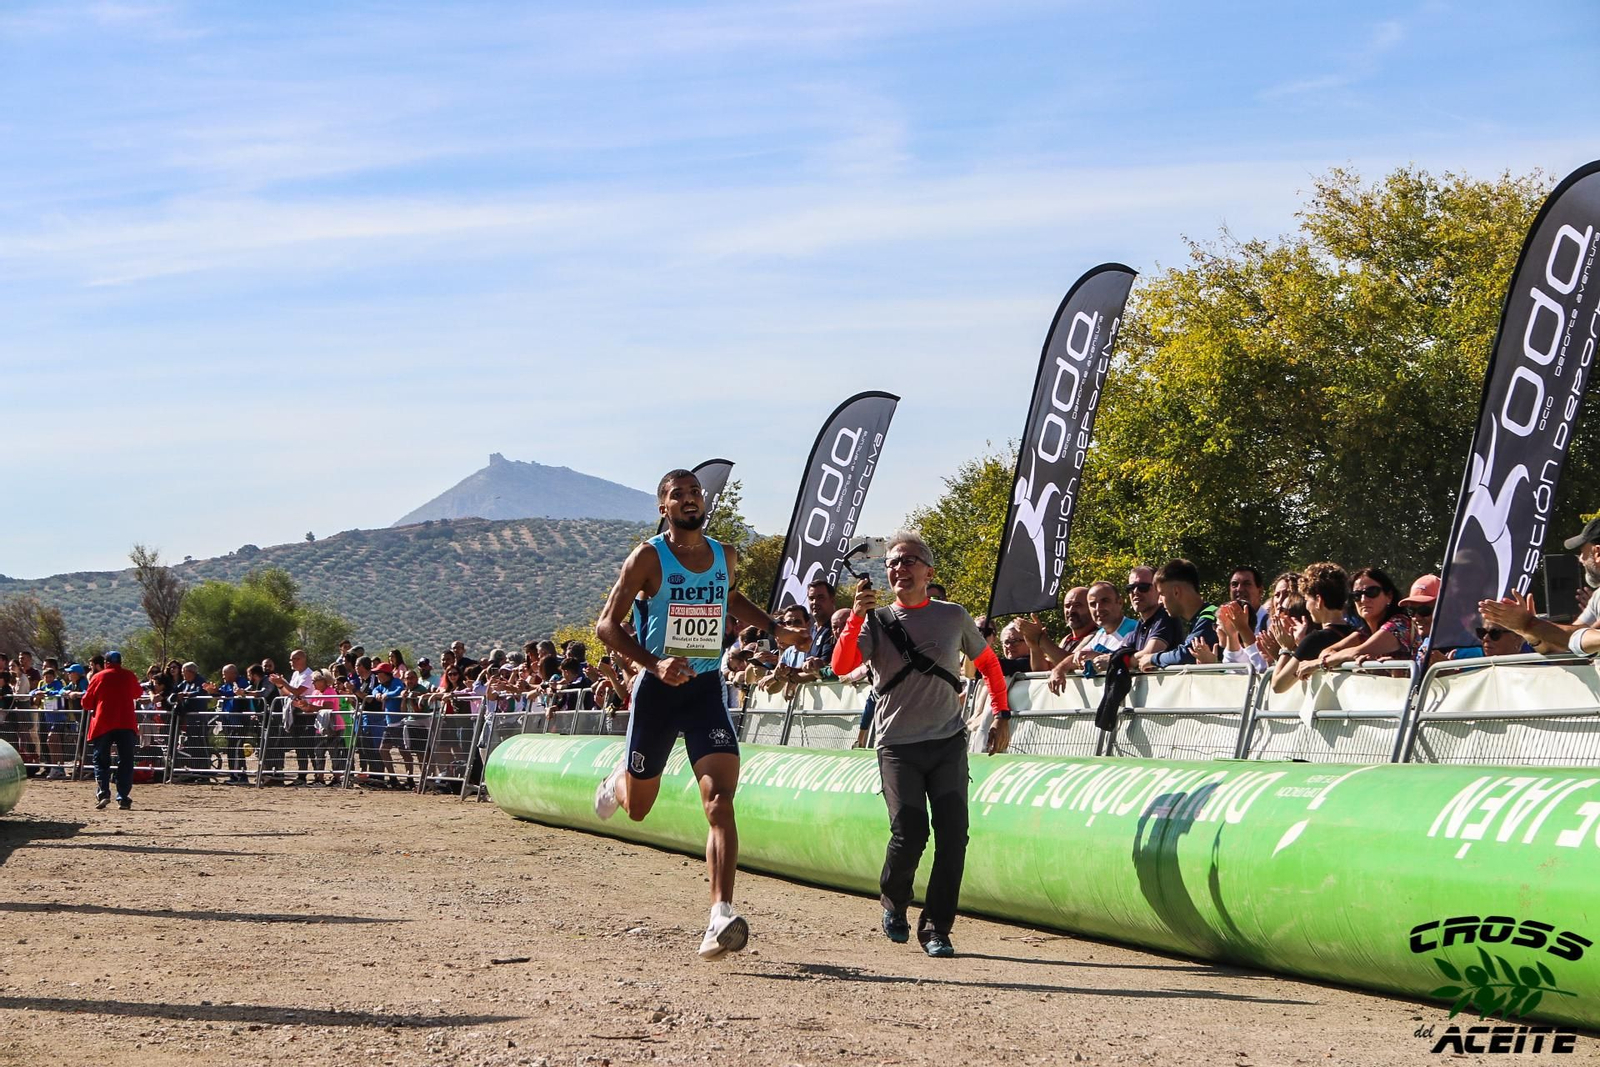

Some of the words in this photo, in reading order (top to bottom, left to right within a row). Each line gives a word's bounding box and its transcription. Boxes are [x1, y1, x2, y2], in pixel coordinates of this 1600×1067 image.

[1516, 458, 1559, 597] estión
[670, 581, 724, 604] nerja
[673, 618, 718, 636] 1002
[971, 762, 1061, 816] JAÉN
[1032, 764, 1100, 808] DE
[1070, 766, 1287, 826] DIPUTACIÓN
[1427, 776, 1600, 859] JAÉN
